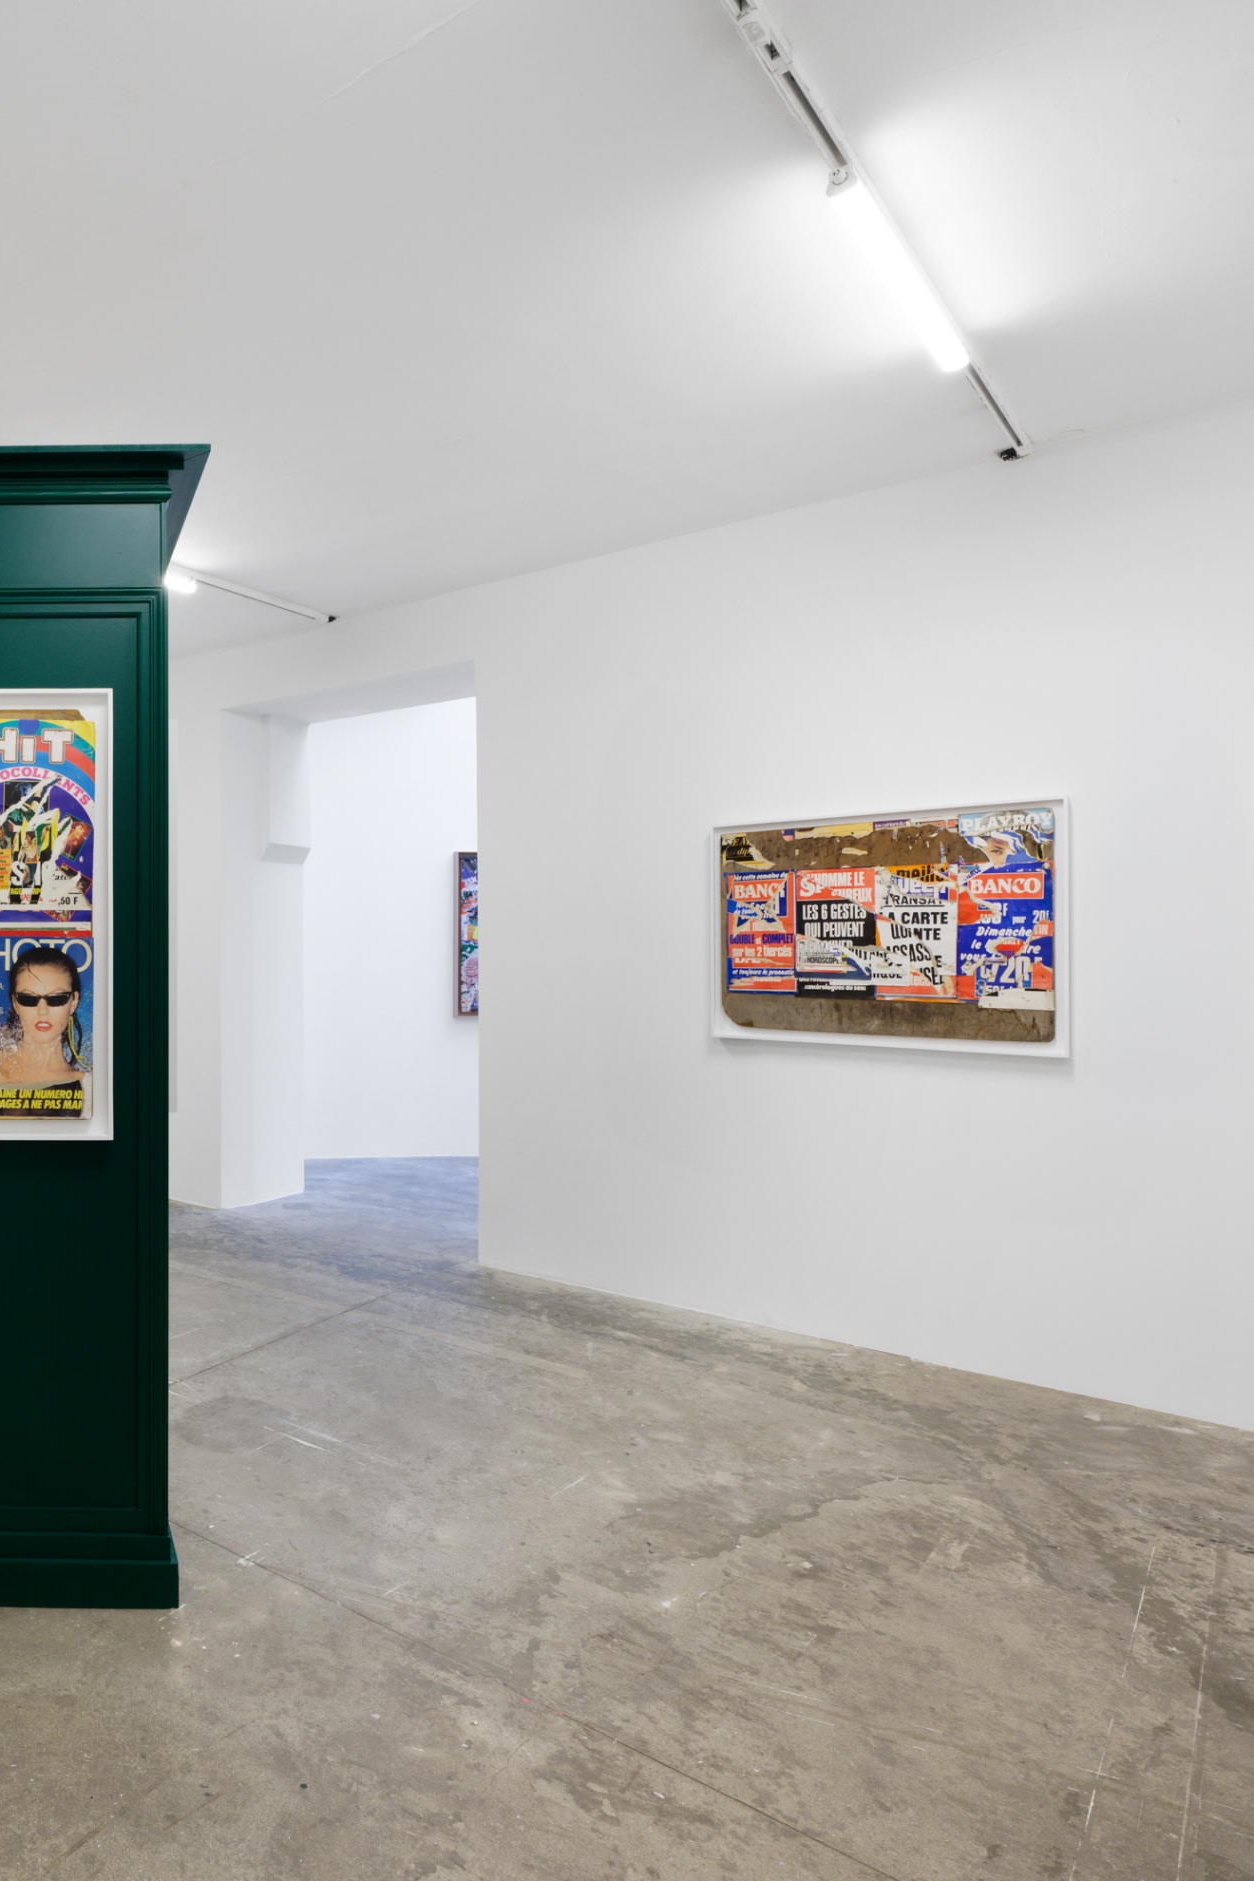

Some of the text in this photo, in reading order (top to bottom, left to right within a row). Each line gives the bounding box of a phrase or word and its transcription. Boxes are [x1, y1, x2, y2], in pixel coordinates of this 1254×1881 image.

[962, 811, 1053, 832] PLAYBOY
[969, 878, 1042, 894] BANCO
[802, 902, 867, 920] LES 6 GESTES
[901, 911, 949, 925] CARTE
[804, 921, 865, 938] QUI PEUVENT
[975, 926, 1033, 937] Dimanche
[762, 933, 794, 945] COMPLET
[19, 1089, 33, 1099] UN
[33, 1089, 73, 1100] NUMERO
[30, 1099, 43, 1109] NE
[44, 1099, 62, 1110] PAS
